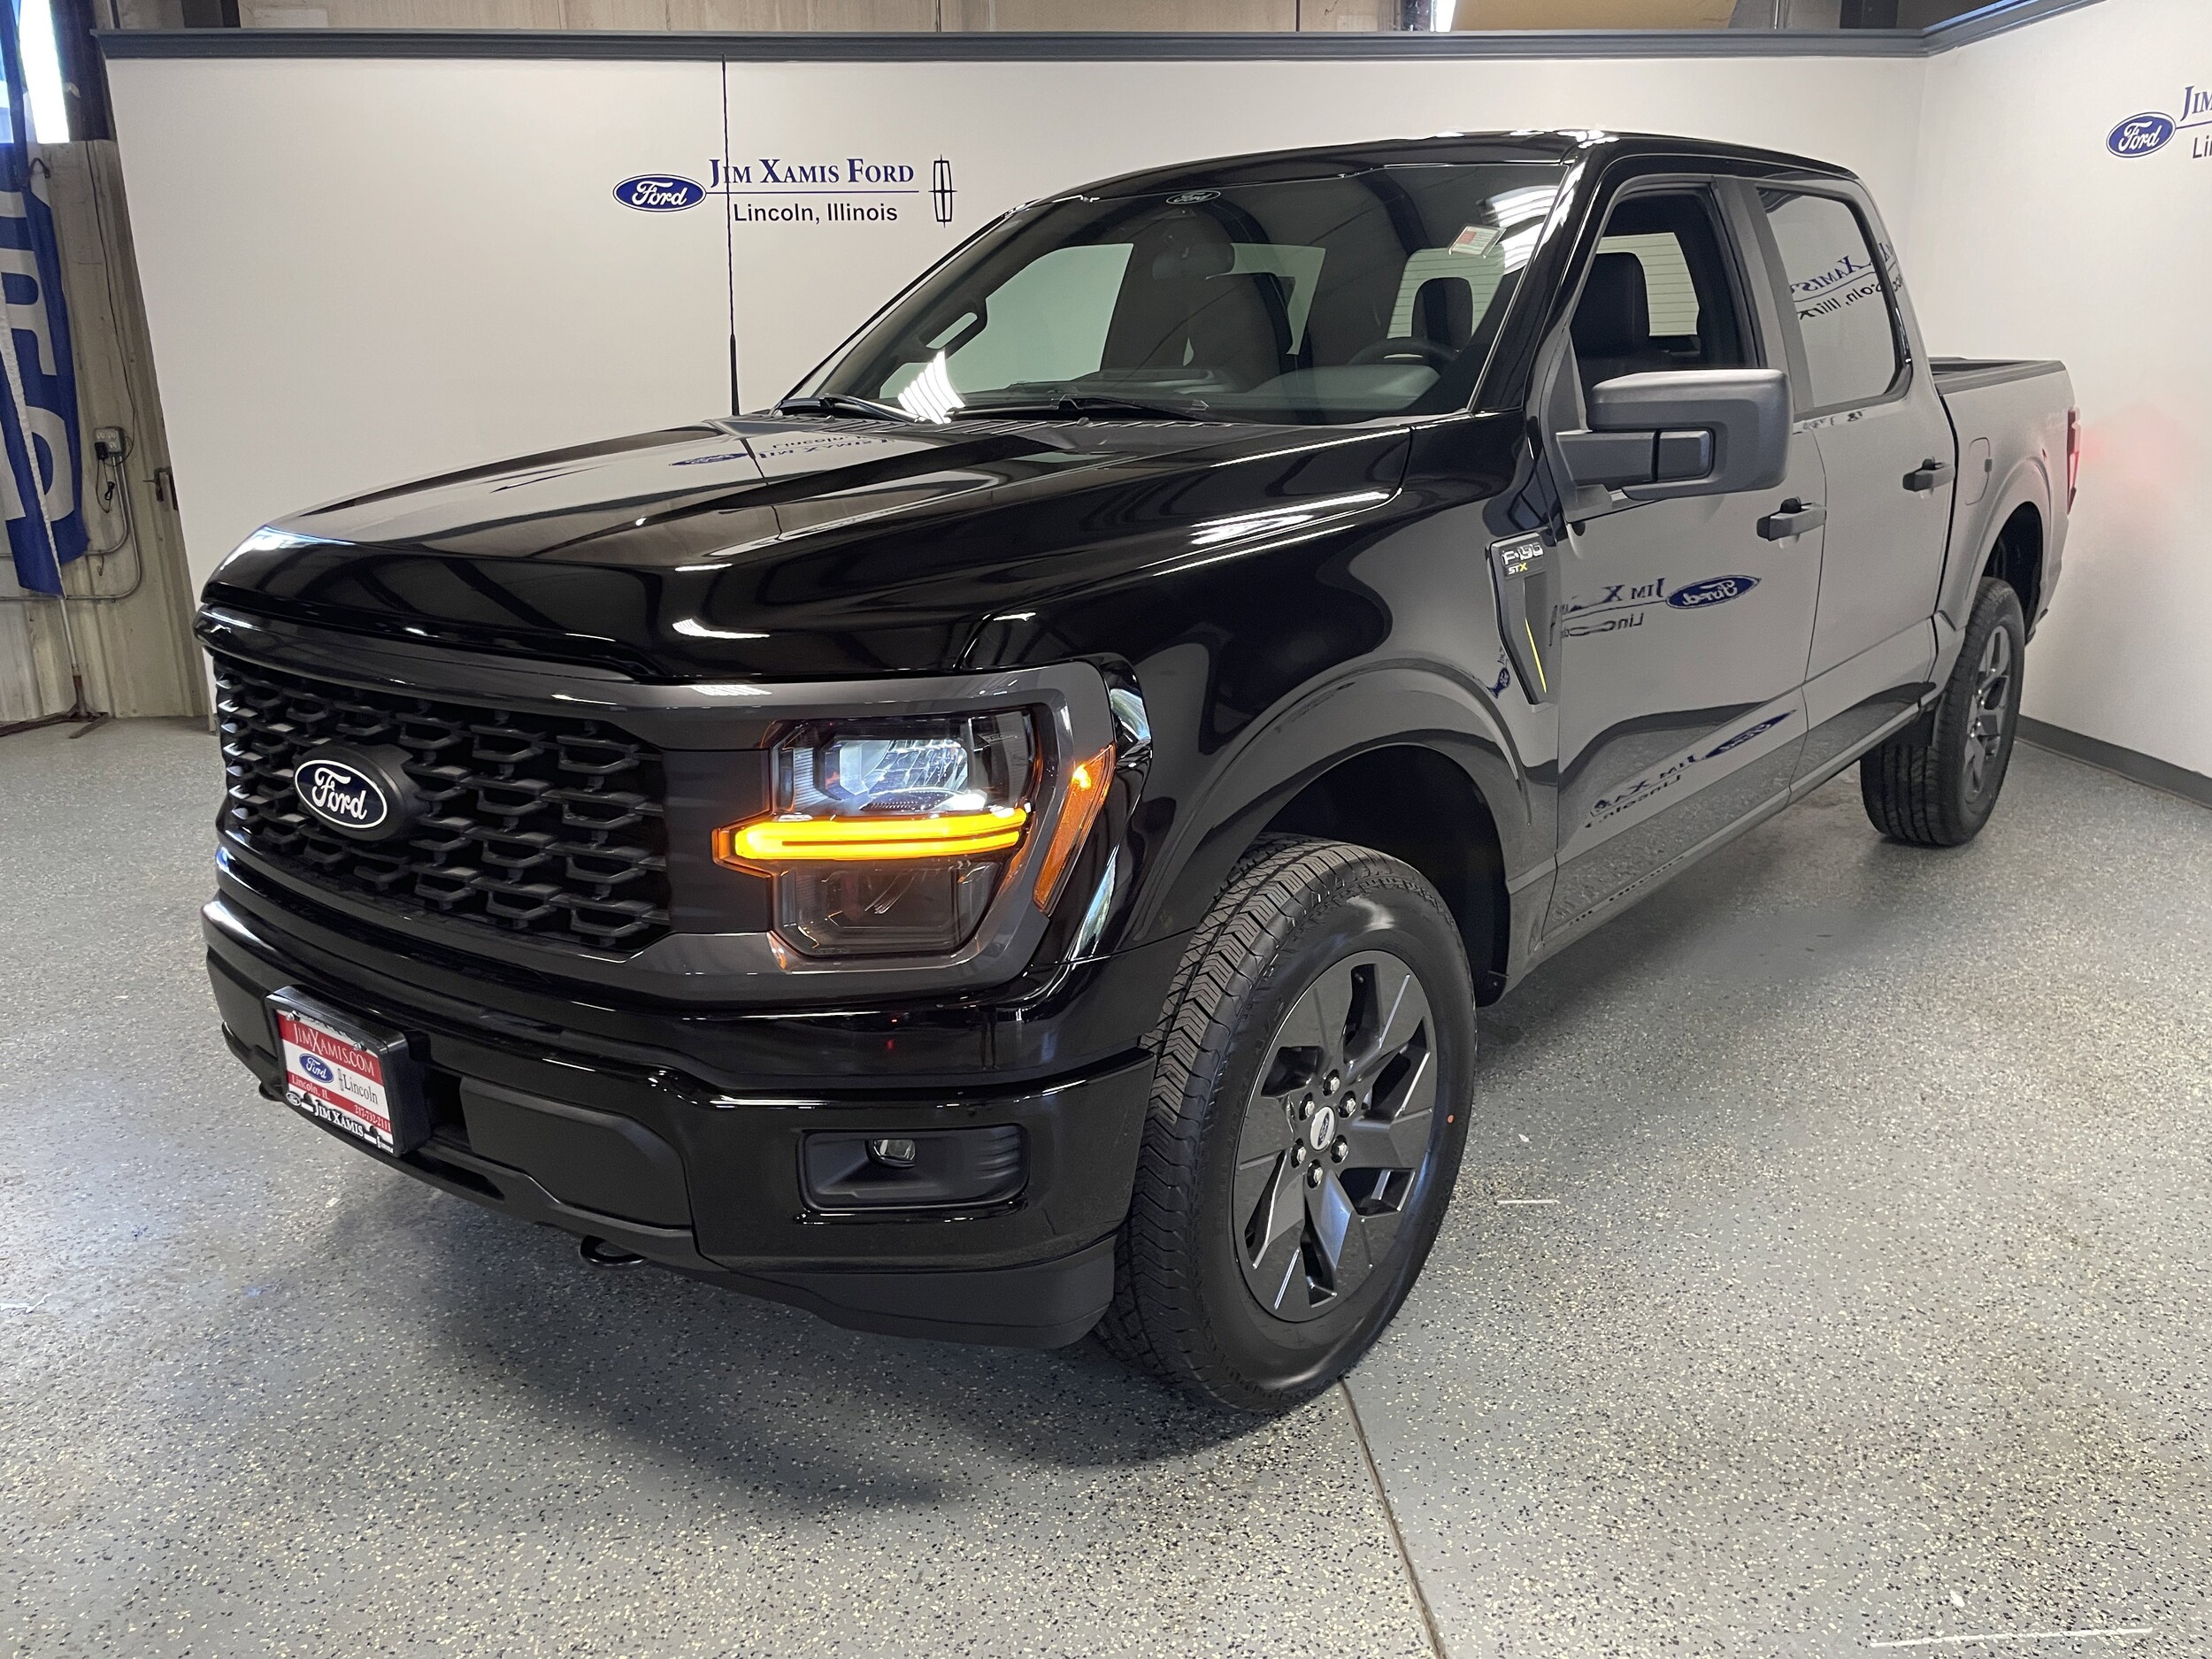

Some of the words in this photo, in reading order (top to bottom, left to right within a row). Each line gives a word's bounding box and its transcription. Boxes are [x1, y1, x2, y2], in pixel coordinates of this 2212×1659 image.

[2118, 120, 2162, 151] Ford
[759, 158, 840, 184] XAMIS
[847, 158, 915, 183] FORD
[632, 180, 687, 209] Ford
[733, 204, 820, 225] Lincoln,
[827, 203, 898, 221] Illinois
[1508, 562, 1527, 575] STX
[312, 767, 368, 820] Ford
[306, 1056, 327, 1079] Ford
[292, 1074, 320, 1097] Lincoln,
[322, 1088, 330, 1101] IL
[344, 1073, 379, 1105] Lincoln
[314, 1099, 332, 1121] JIM
[332, 1110, 365, 1138] XAMIS
